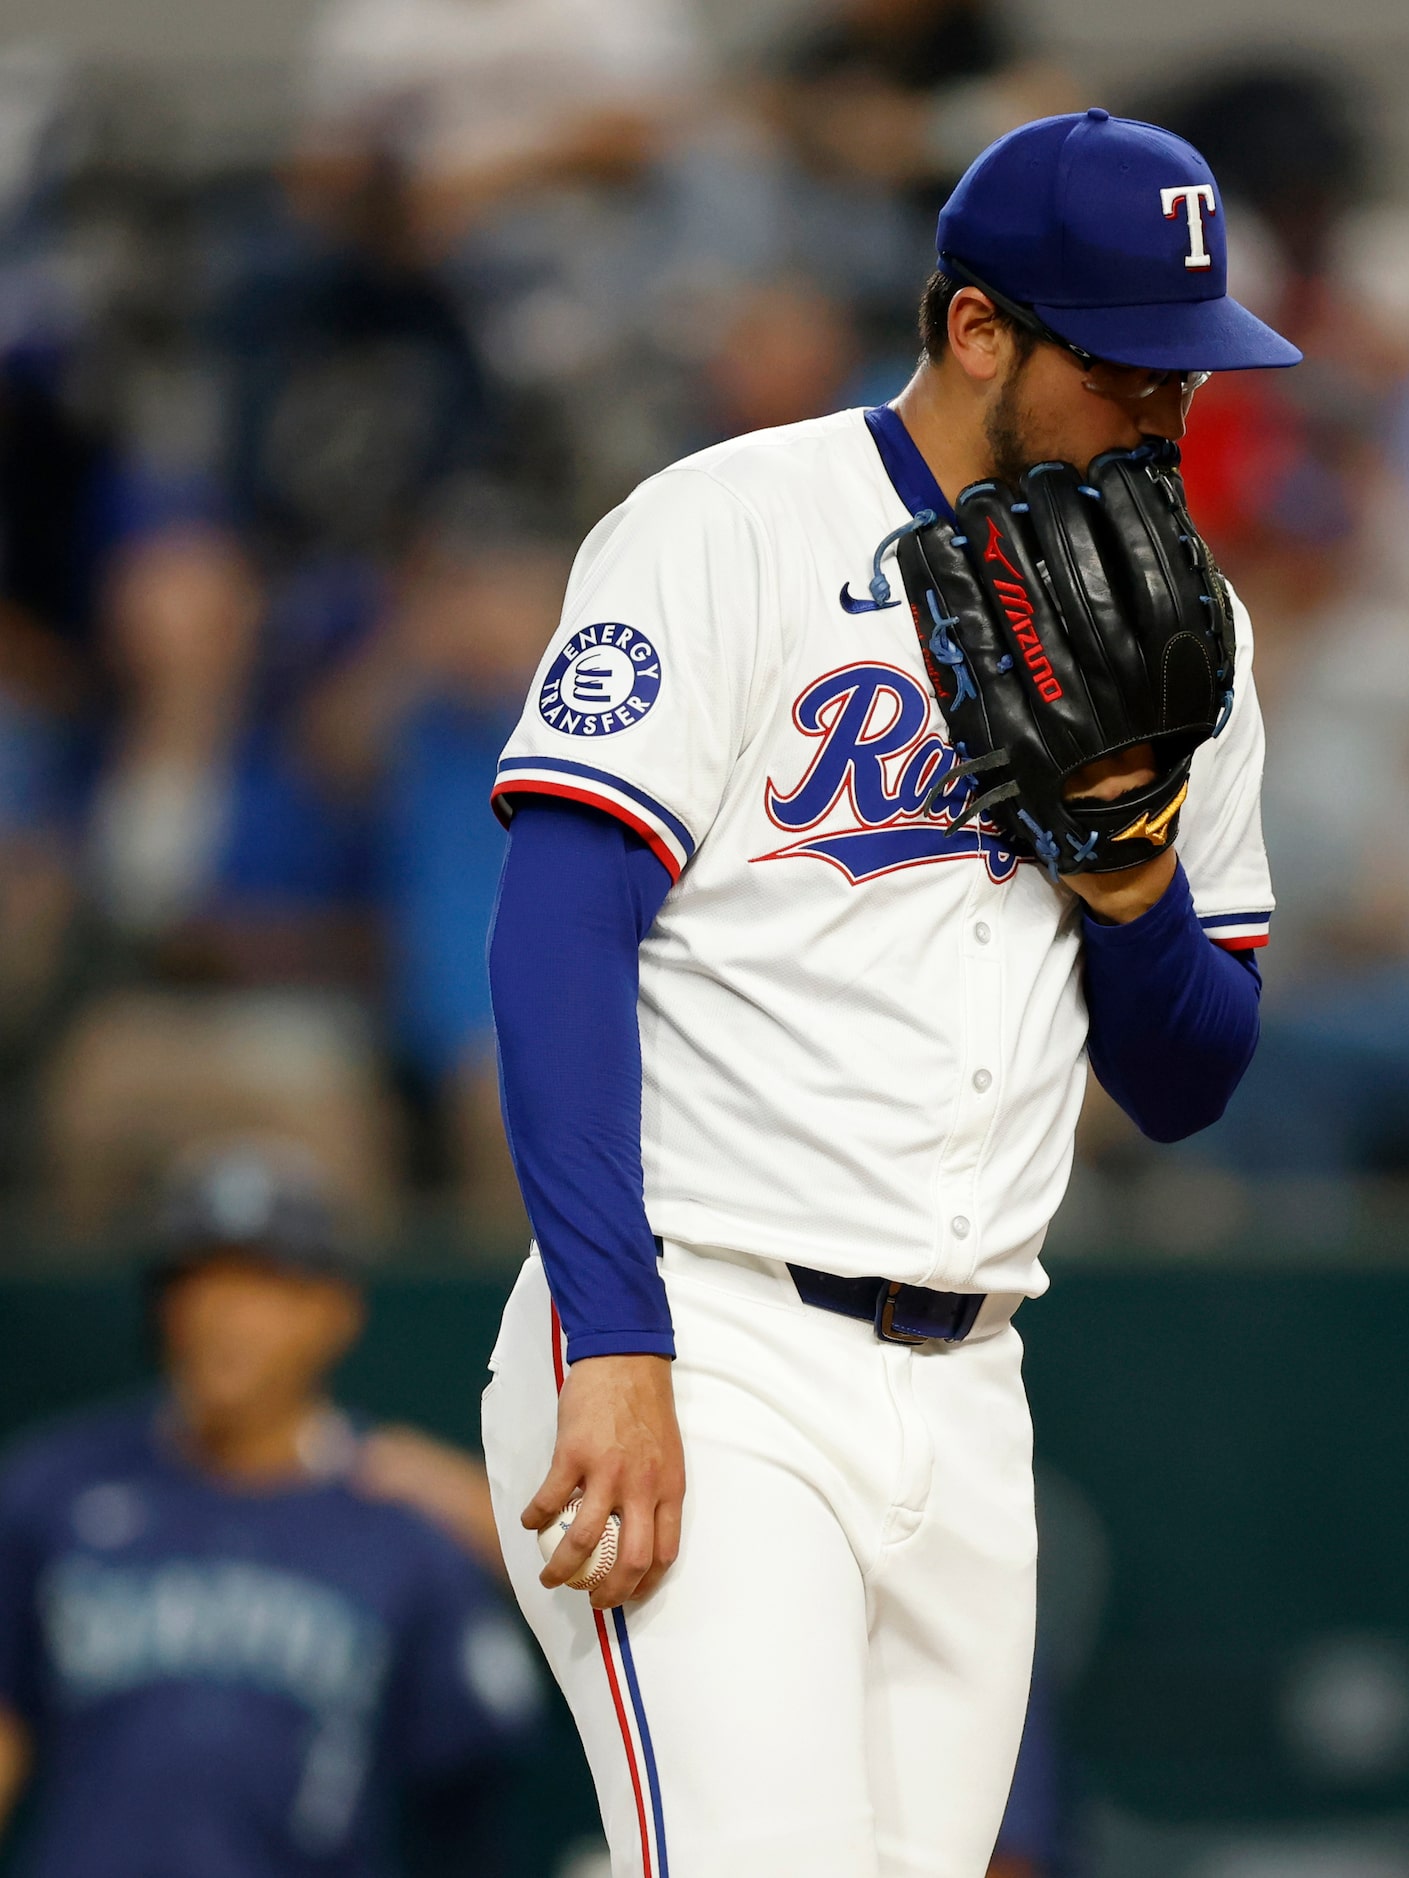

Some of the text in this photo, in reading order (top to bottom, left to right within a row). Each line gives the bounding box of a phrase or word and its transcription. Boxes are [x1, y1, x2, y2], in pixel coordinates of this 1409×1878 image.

[1160, 184, 1216, 273] T
[562, 624, 660, 680] ENERGY
[540, 678, 652, 735] TRANSFER
